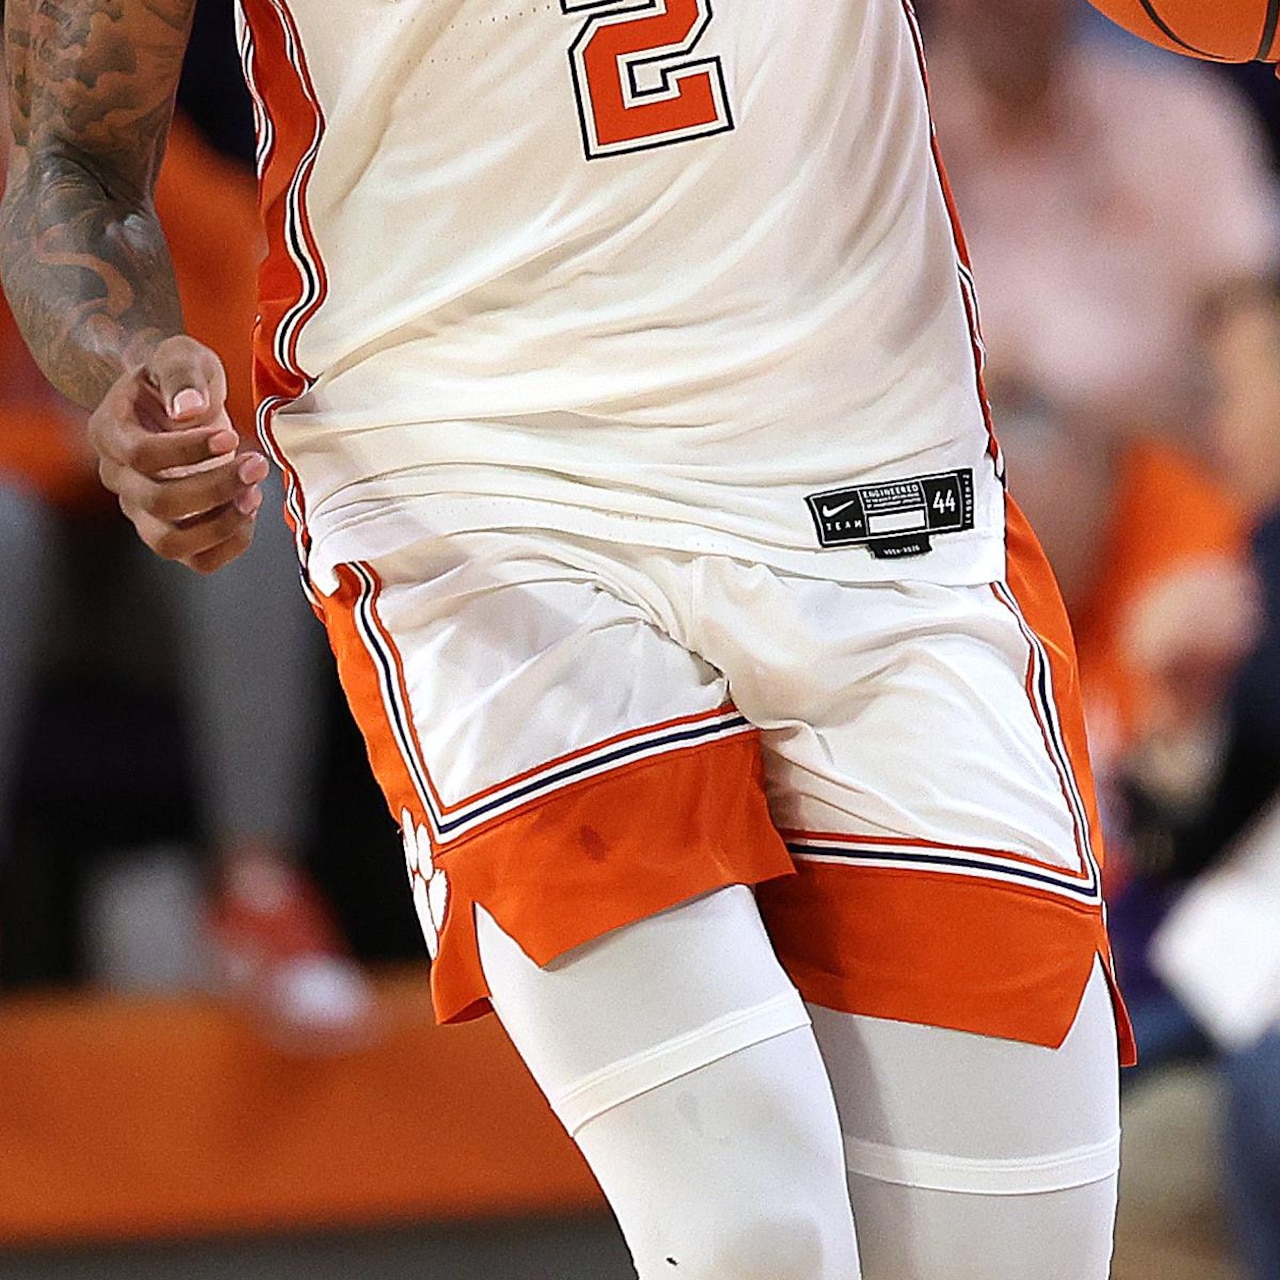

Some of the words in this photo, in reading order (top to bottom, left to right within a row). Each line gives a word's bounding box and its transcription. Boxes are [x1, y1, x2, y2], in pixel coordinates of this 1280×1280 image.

[862, 483, 919, 499] ENGINEERED
[932, 489, 956, 515] 44
[825, 519, 863, 531] TEAM
